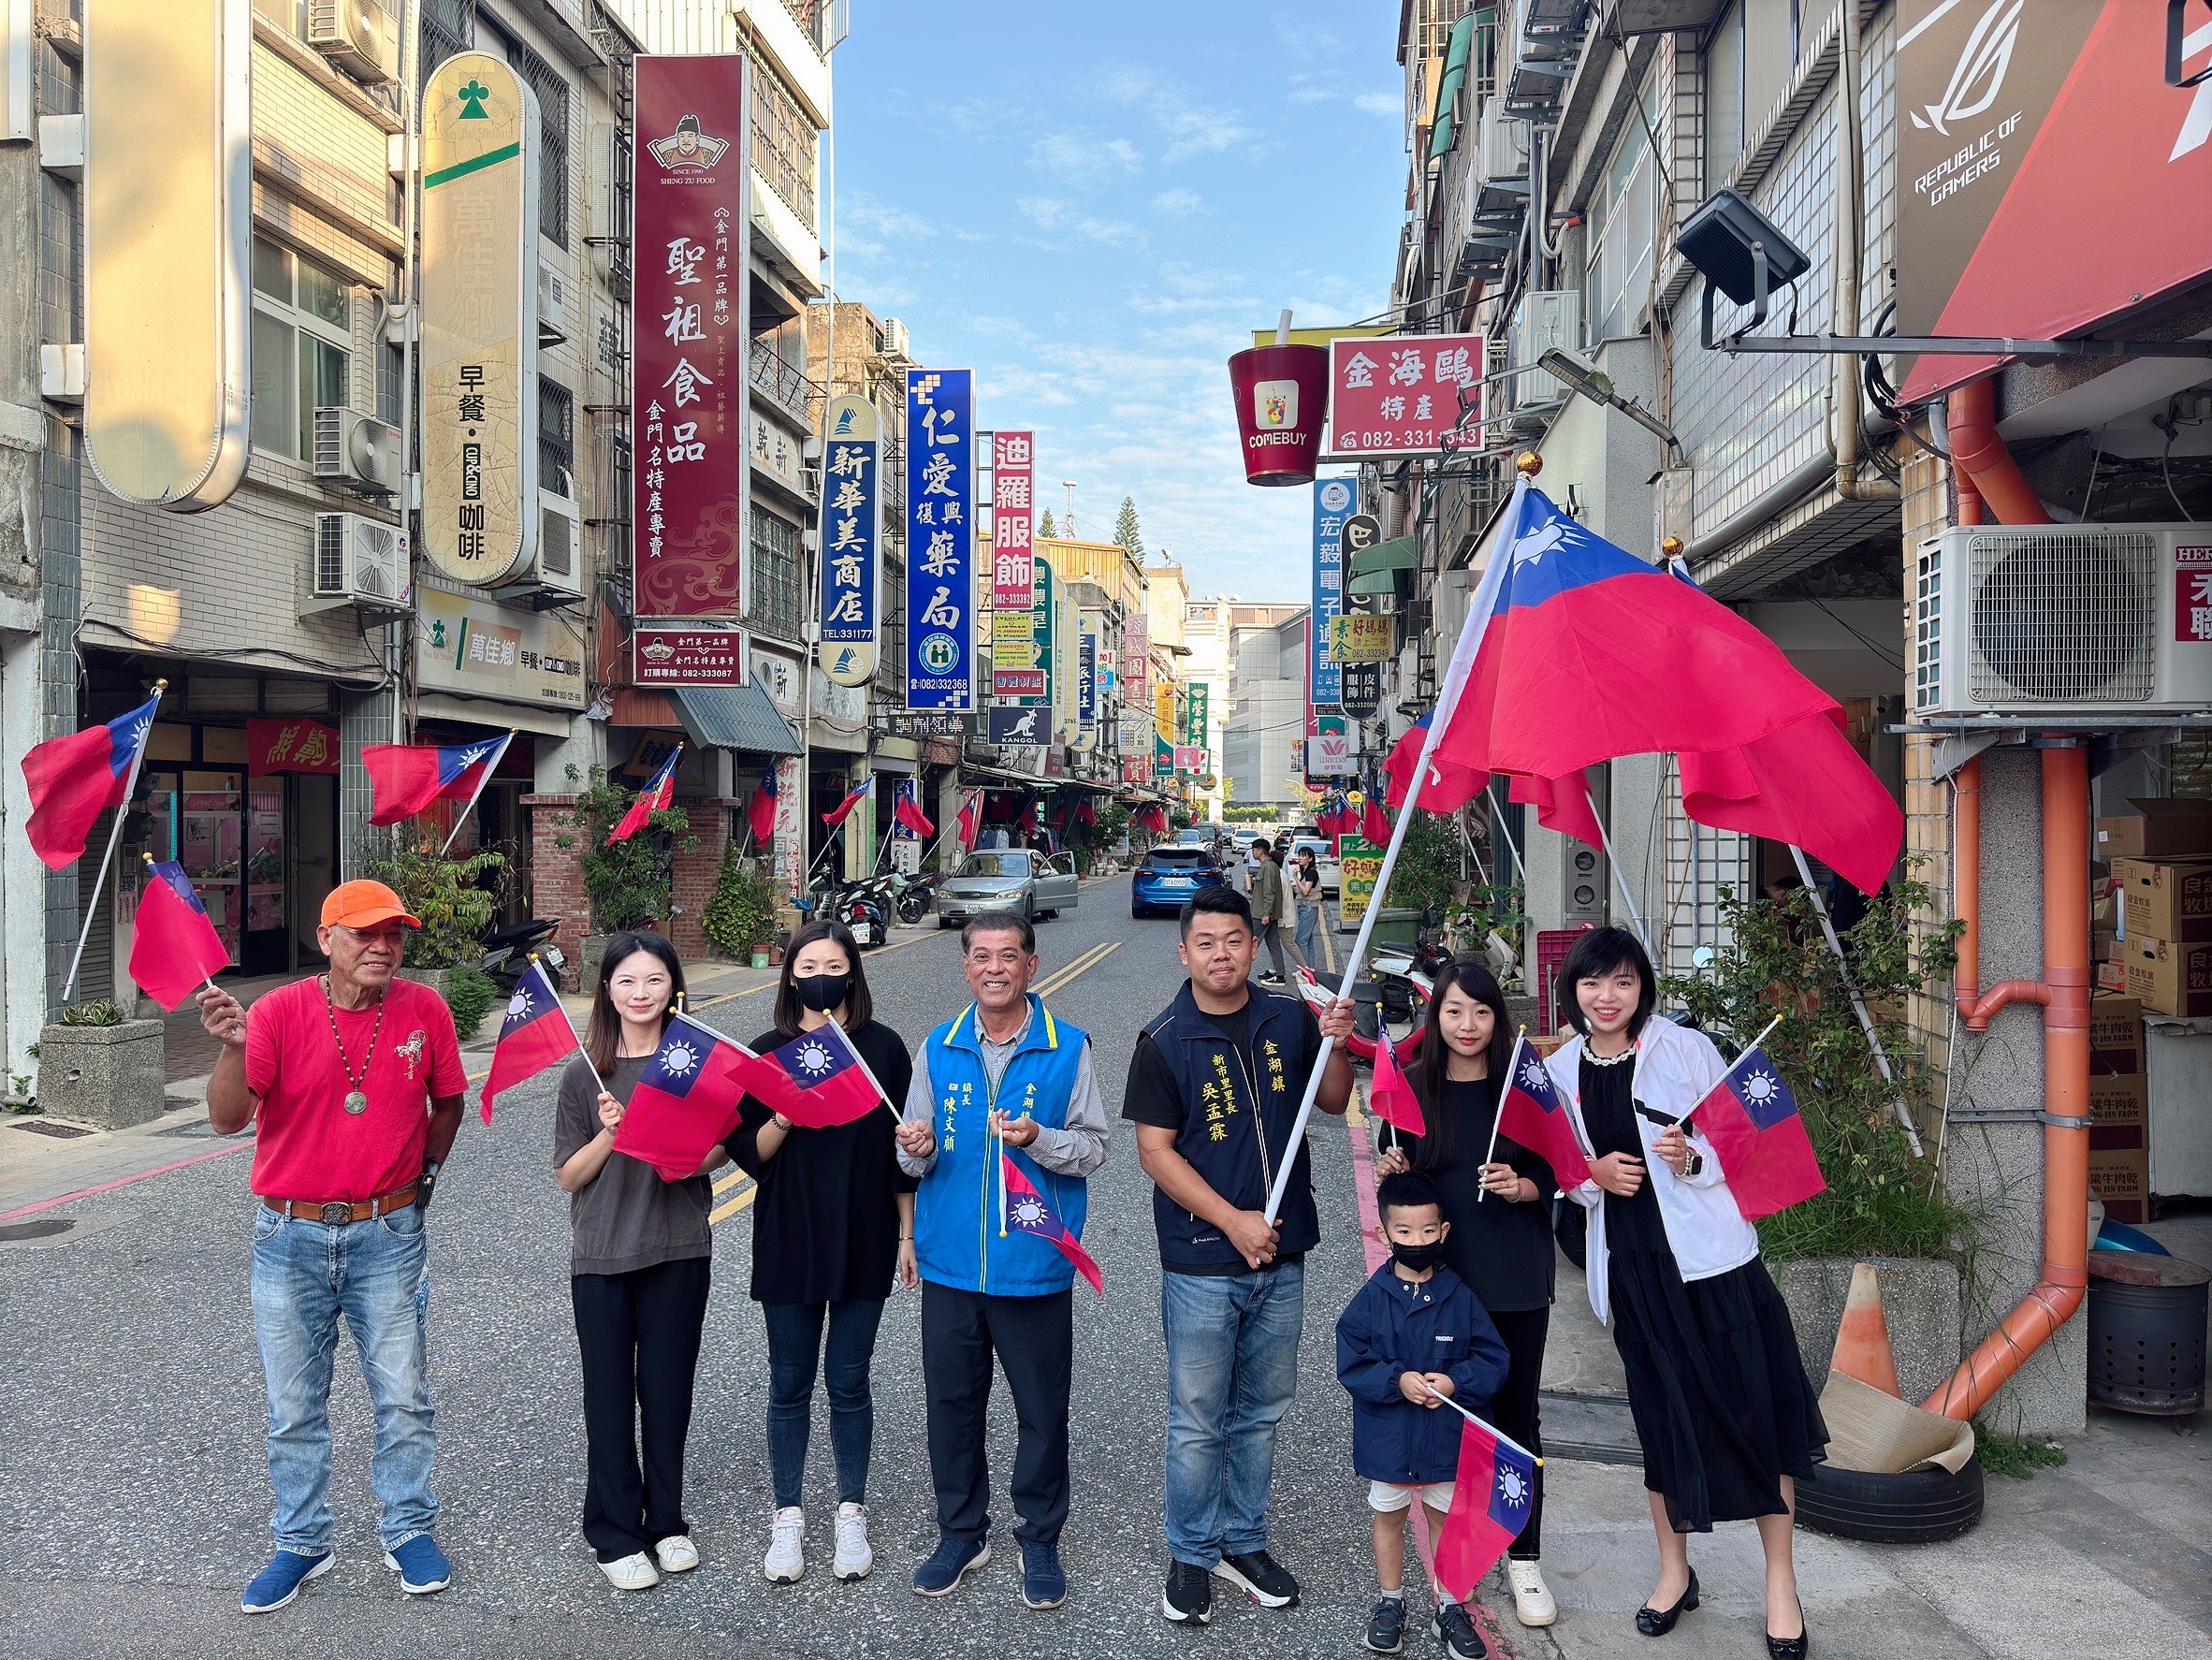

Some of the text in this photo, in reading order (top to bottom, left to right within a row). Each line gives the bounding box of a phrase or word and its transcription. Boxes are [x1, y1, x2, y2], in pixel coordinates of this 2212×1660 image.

[1914, 109, 2023, 195] REPUBLIC OF
[1930, 149, 2001, 207] GAMERS
[714, 218, 729, 313] 金門第一品牌
[662, 237, 713, 464] 聖祖食品
[1380, 394, 1433, 422] 特產
[1249, 432, 1307, 448] COMEBUY
[645, 400, 665, 559] 金門名特產專賣
[458, 503, 486, 561] 咖啡
[827, 444, 871, 623] 新華美商店
[995, 436, 1030, 588] 迪羅服飾
[995, 593, 1030, 604] 082-333392
[470, 633, 516, 667] 萬佳鄉
[677, 637, 729, 647] 金門第一品牌
[1332, 619, 1352, 659] 素食
[1353, 619, 1389, 635] 好媽媽
[674, 656, 735, 665] 金門名特產專賣
[682, 669, 733, 677] 082-333087
[1363, 673, 1375, 699] 皮件
[1212, 1054, 1238, 1114] 新市里里長
[1263, 1039, 1286, 1093] 金湖鎮
[961, 1082, 973, 1106] 鎮長
[1201, 1082, 1230, 1142] 吳孟霖
